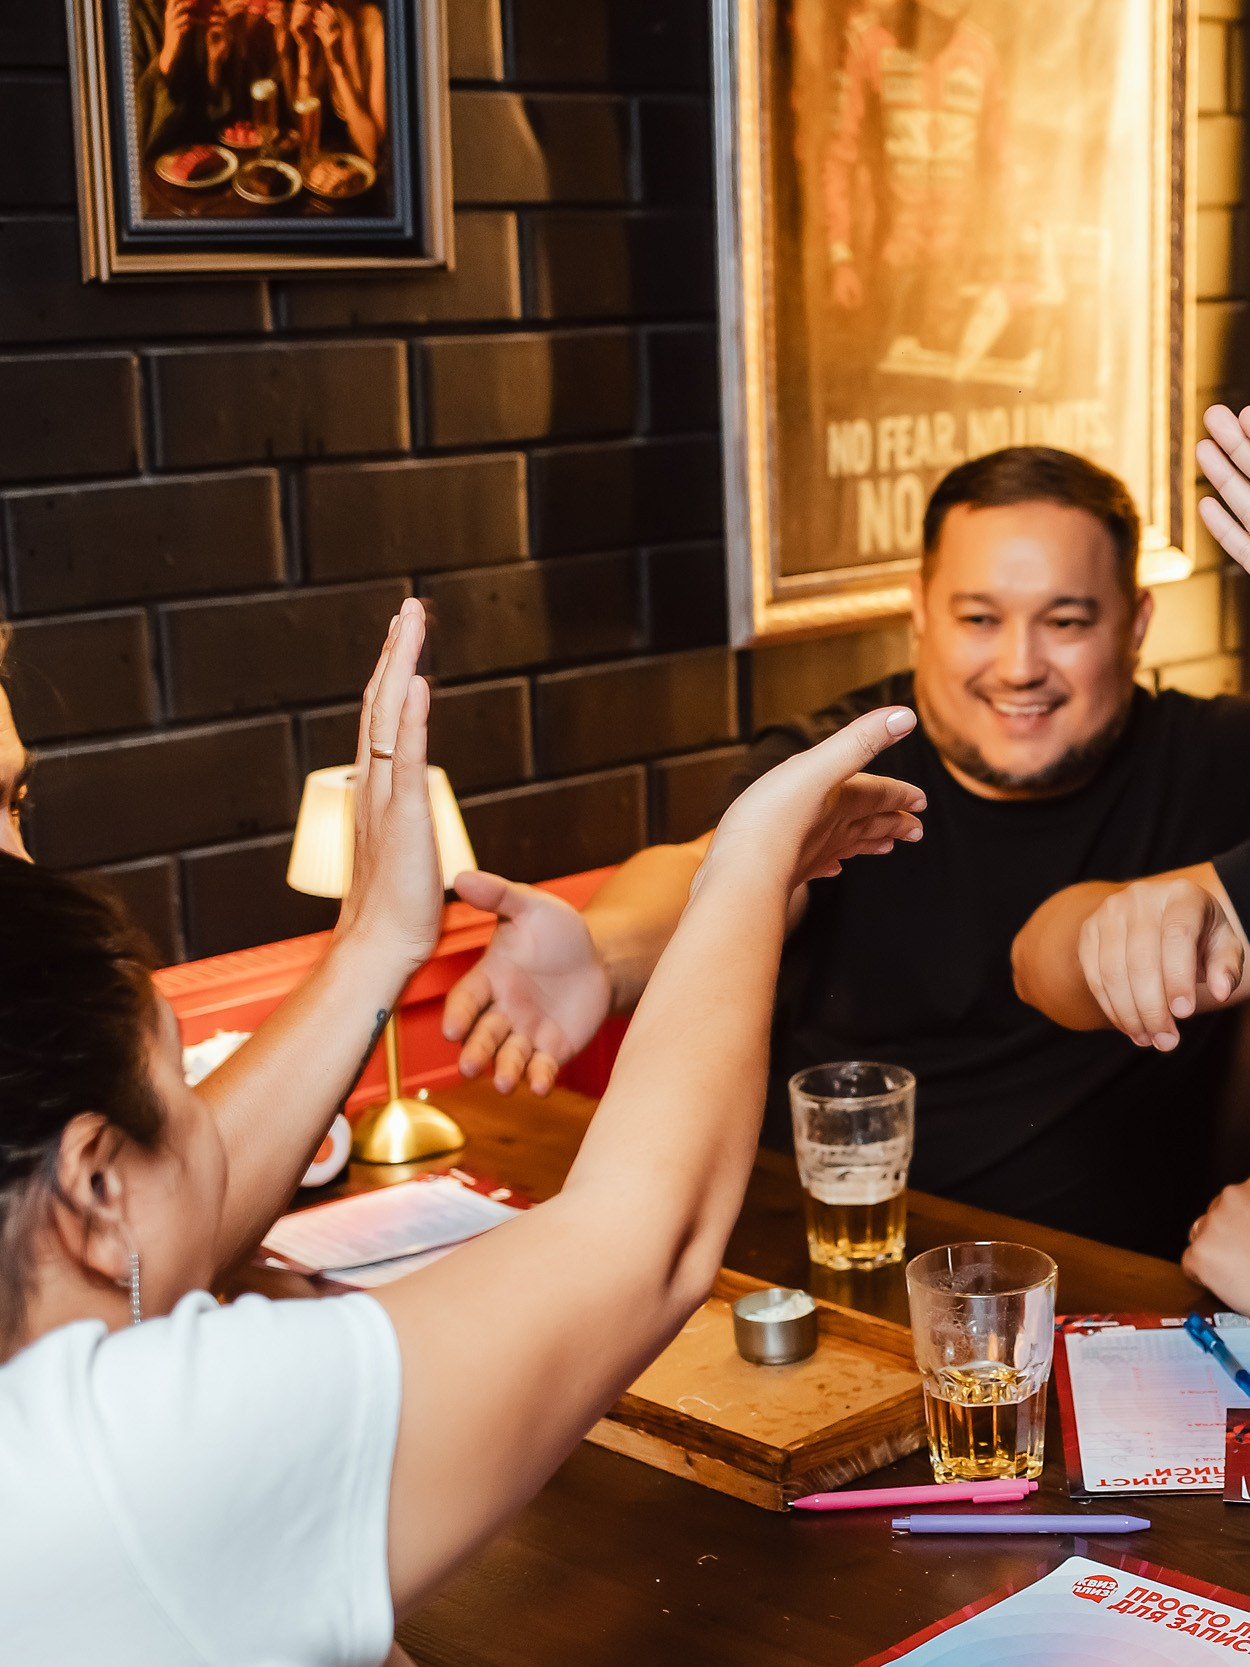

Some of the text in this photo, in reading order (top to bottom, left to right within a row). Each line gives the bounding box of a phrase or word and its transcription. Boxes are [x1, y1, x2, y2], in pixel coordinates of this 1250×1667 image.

[826, 417, 873, 478] NO
[856, 471, 925, 556] NO
[1096, 1477, 1168, 1487] ЛИСТ
[1106, 1599, 1167, 1624] ДЛЯ
[1125, 1586, 1231, 1628] ПРОСТО
